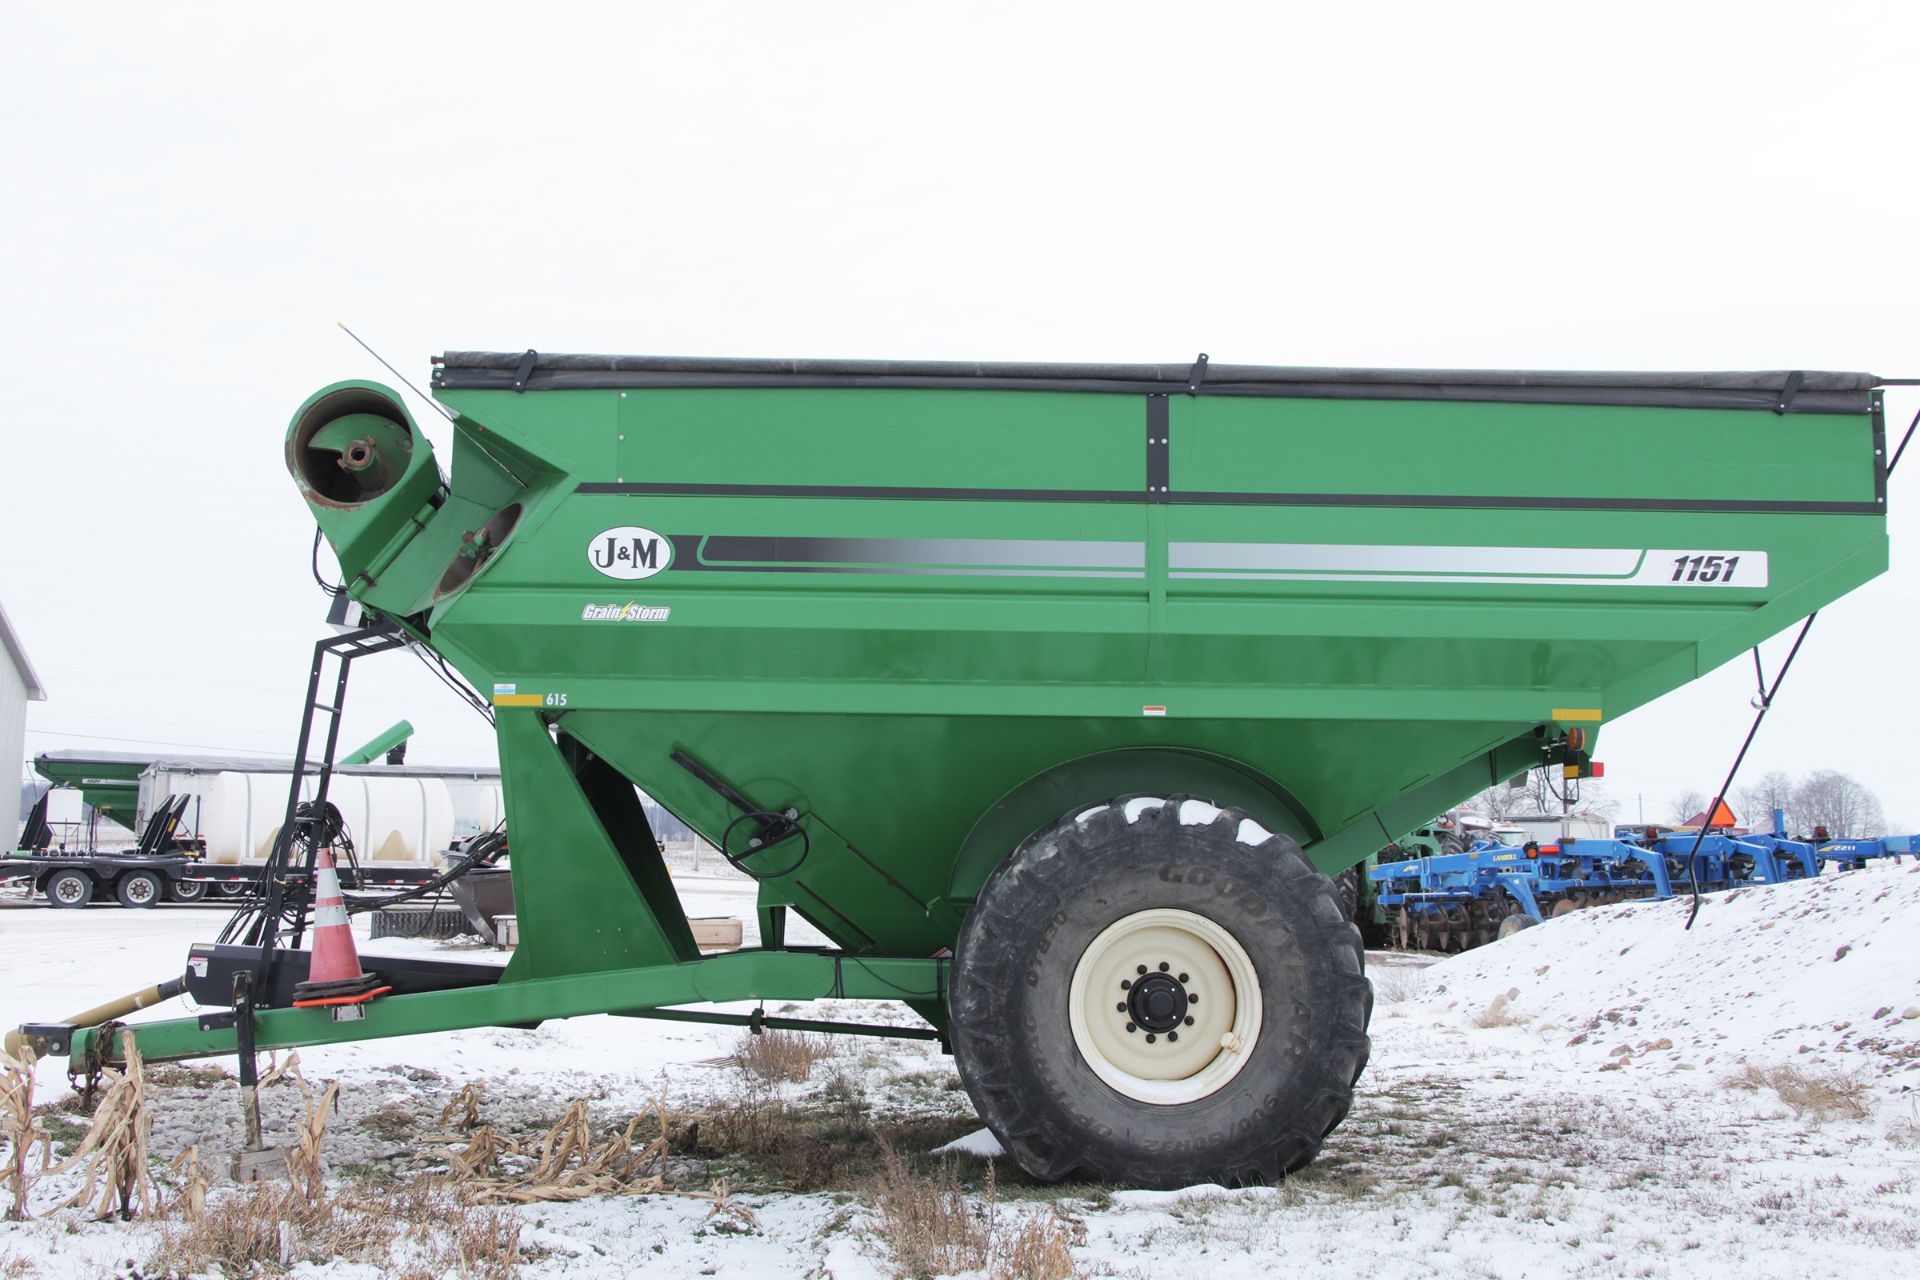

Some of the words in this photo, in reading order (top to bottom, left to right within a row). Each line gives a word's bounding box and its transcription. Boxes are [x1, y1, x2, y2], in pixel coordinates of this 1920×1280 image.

[594, 537, 659, 569] J&M
[1671, 555, 1740, 582] 1151
[583, 603, 622, 621] Grain
[627, 604, 671, 621] Storm
[546, 693, 567, 706] 615
